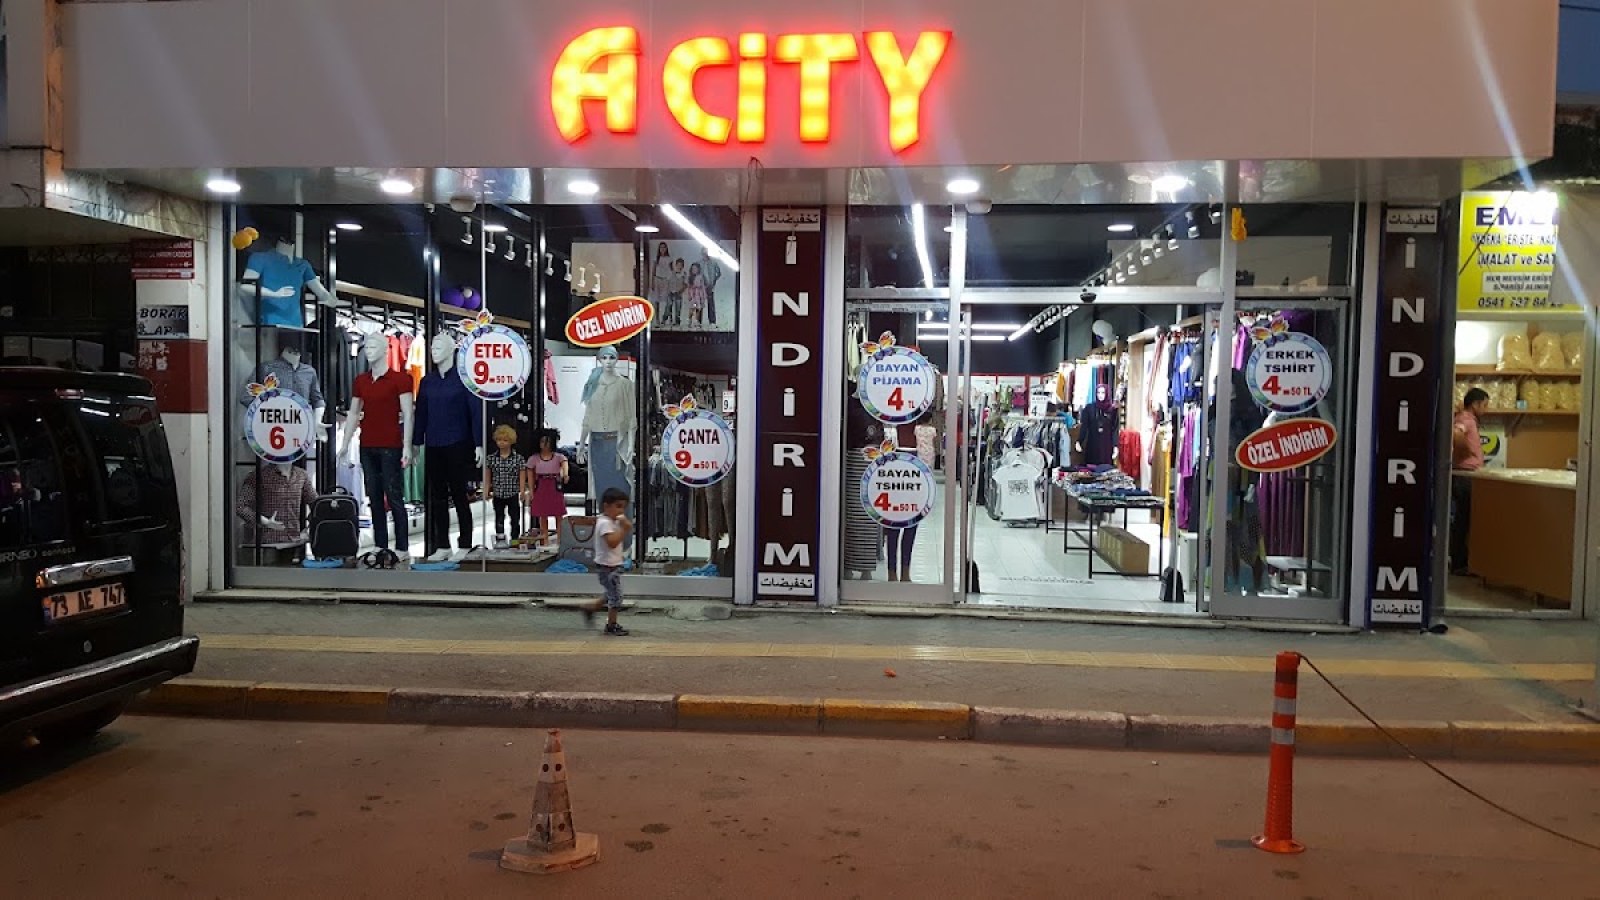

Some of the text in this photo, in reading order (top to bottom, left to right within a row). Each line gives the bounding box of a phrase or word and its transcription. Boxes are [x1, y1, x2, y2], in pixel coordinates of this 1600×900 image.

[551, 26, 642, 144] A
[140, 307, 187, 319] BORAK
[575, 301, 647, 340] ÖZEL İNDİRİM
[475, 343, 513, 359] ETEK
[1266, 350, 1315, 360] ERKEK
[875, 363, 919, 373] BAYAN
[1264, 362, 1316, 373] TSHİRT
[506, 375, 515, 384] TL
[1303, 386, 1313, 396] TL
[887, 387, 916, 412] 4 TL
[259, 404, 302, 425] TERLİK
[270, 426, 286, 449] 6
[678, 428, 721, 449] ÇANTA
[1247, 423, 1330, 465] ÖZEL İNDİRİM
[711, 461, 720, 470] TL
[877, 469, 921, 478] BAYAN
[875, 480, 922, 491] TSHİRT
[911, 503, 920, 512] TL
[760, 577, 813, 591] تخفيضات
[1373, 603, 1421, 618] تخفيضات
